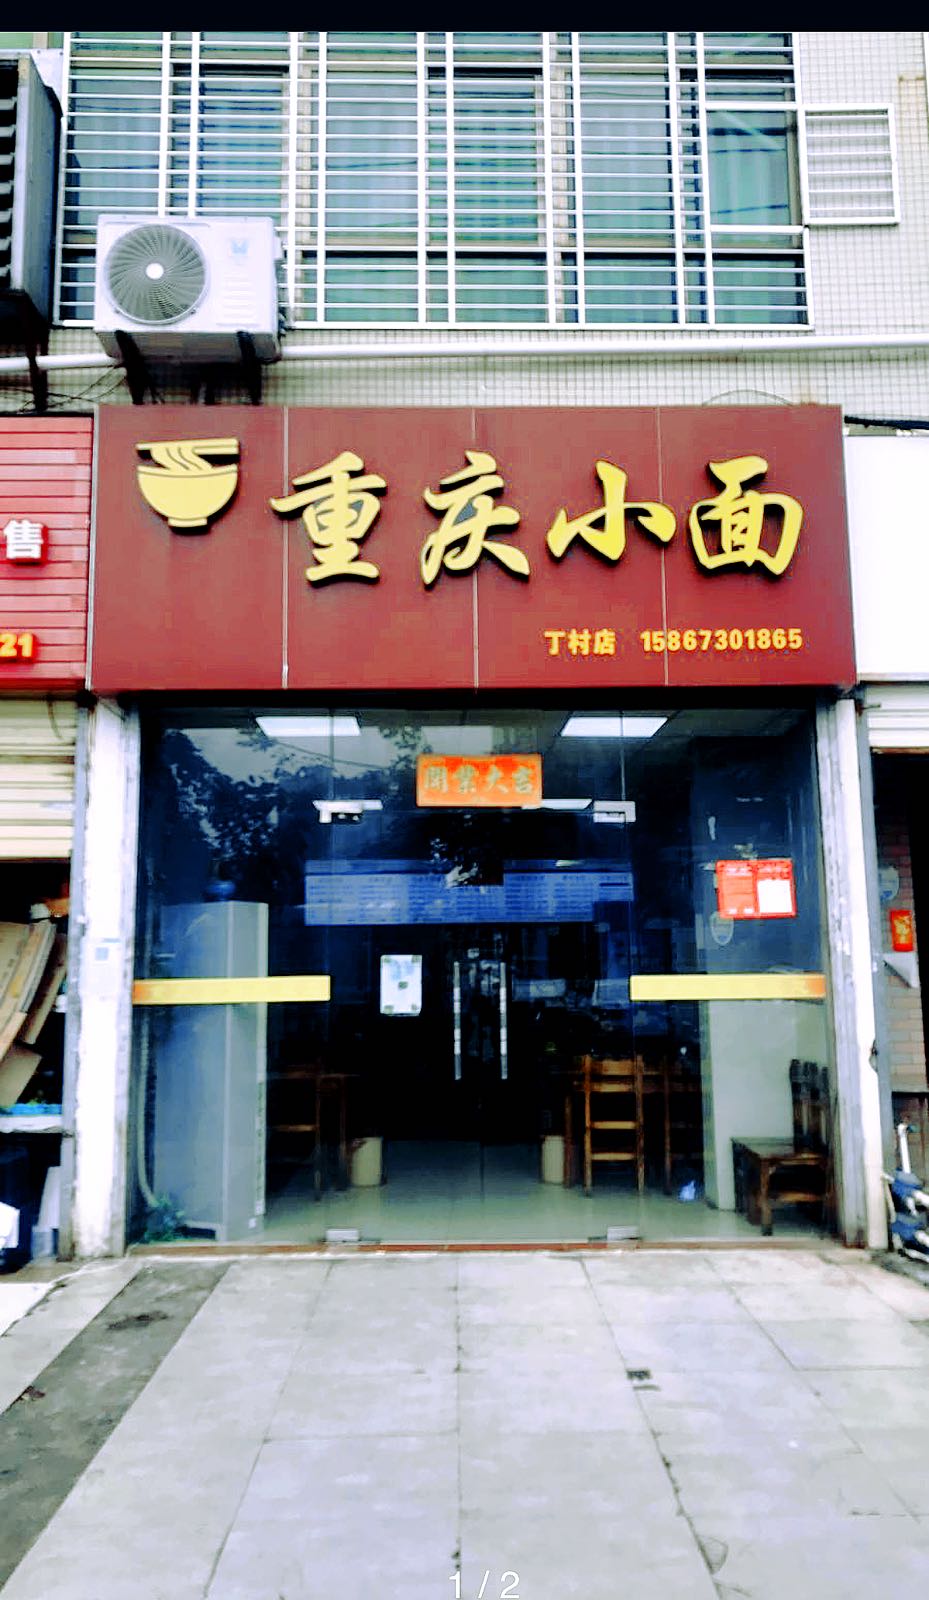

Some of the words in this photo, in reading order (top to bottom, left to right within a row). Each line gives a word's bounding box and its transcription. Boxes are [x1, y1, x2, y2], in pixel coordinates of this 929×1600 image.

[271, 450, 803, 585] 重庆小面
[3, 519, 44, 559] 售
[544, 629, 616, 655] 丁村店
[640, 628, 803, 652] 15867301865
